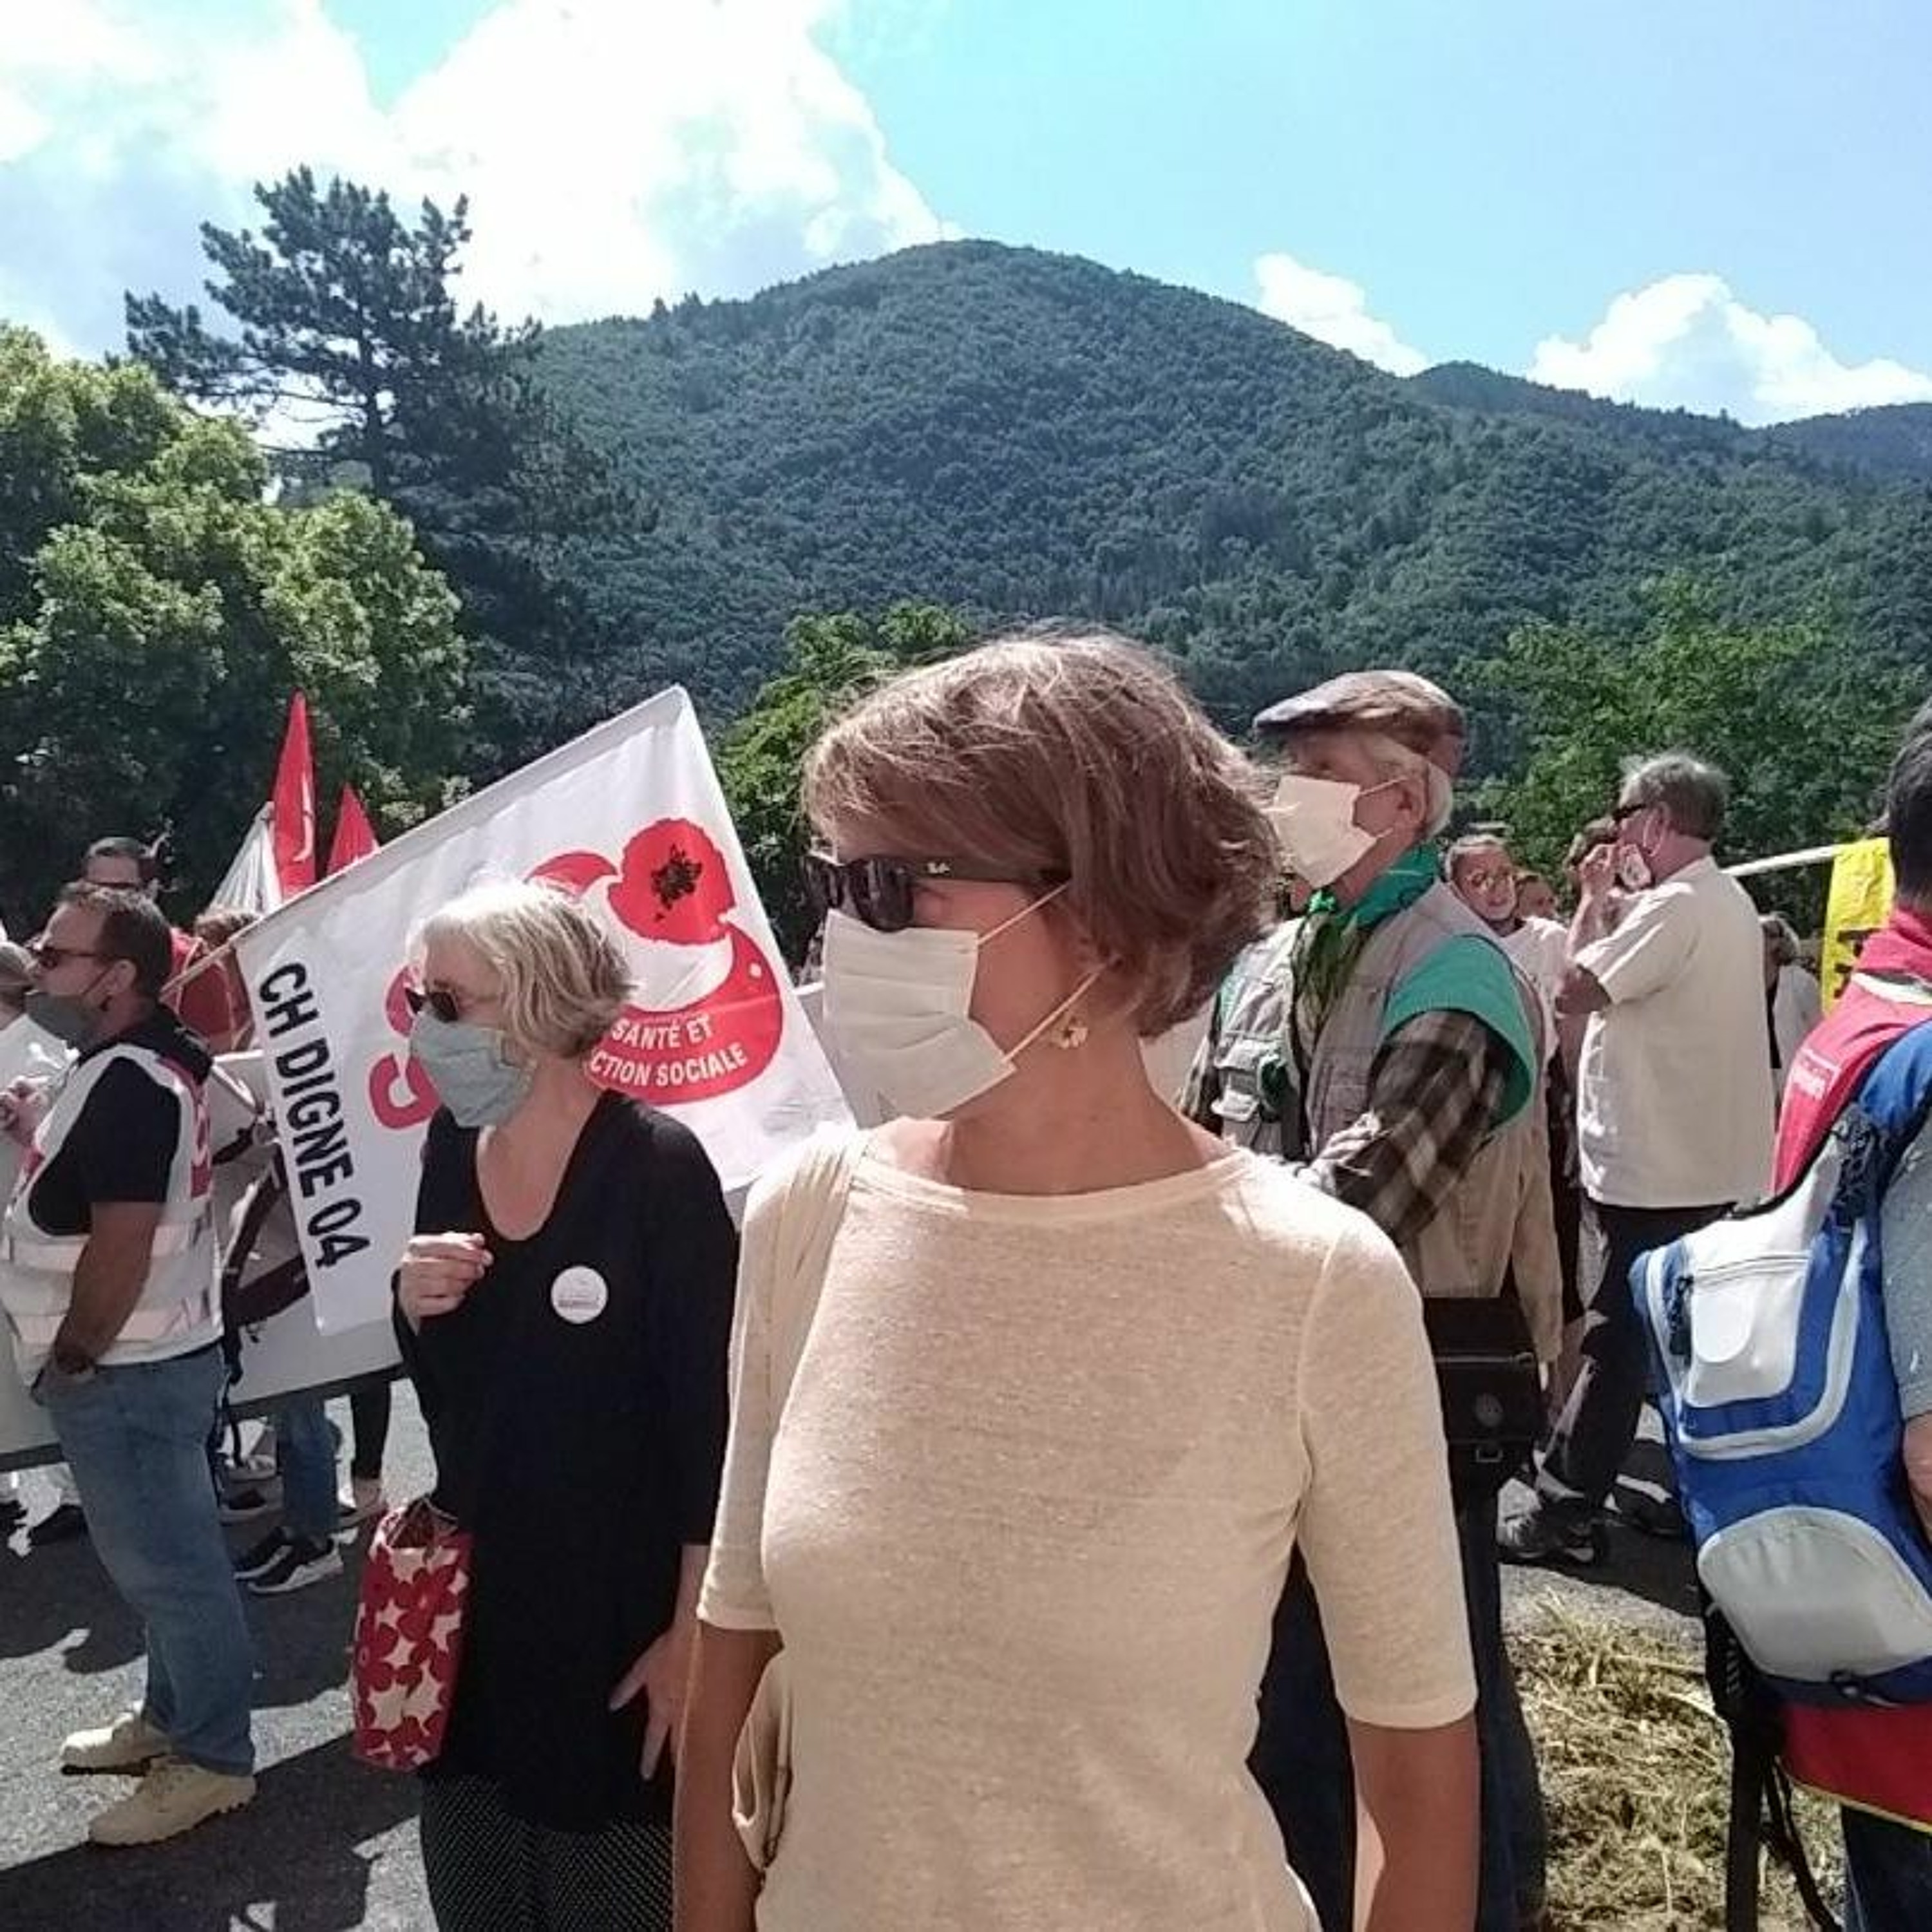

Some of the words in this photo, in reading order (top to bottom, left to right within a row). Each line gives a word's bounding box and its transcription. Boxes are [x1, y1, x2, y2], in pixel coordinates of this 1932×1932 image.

[259, 963, 319, 1037] CH
[611, 1018, 681, 1050] SANTÉ
[687, 1014, 714, 1044] ET
[589, 1048, 652, 1086] CTION
[656, 1041, 748, 1087] SOCIALE
[276, 1037, 354, 1198] DIGNE
[307, 1198, 370, 1269] 04
